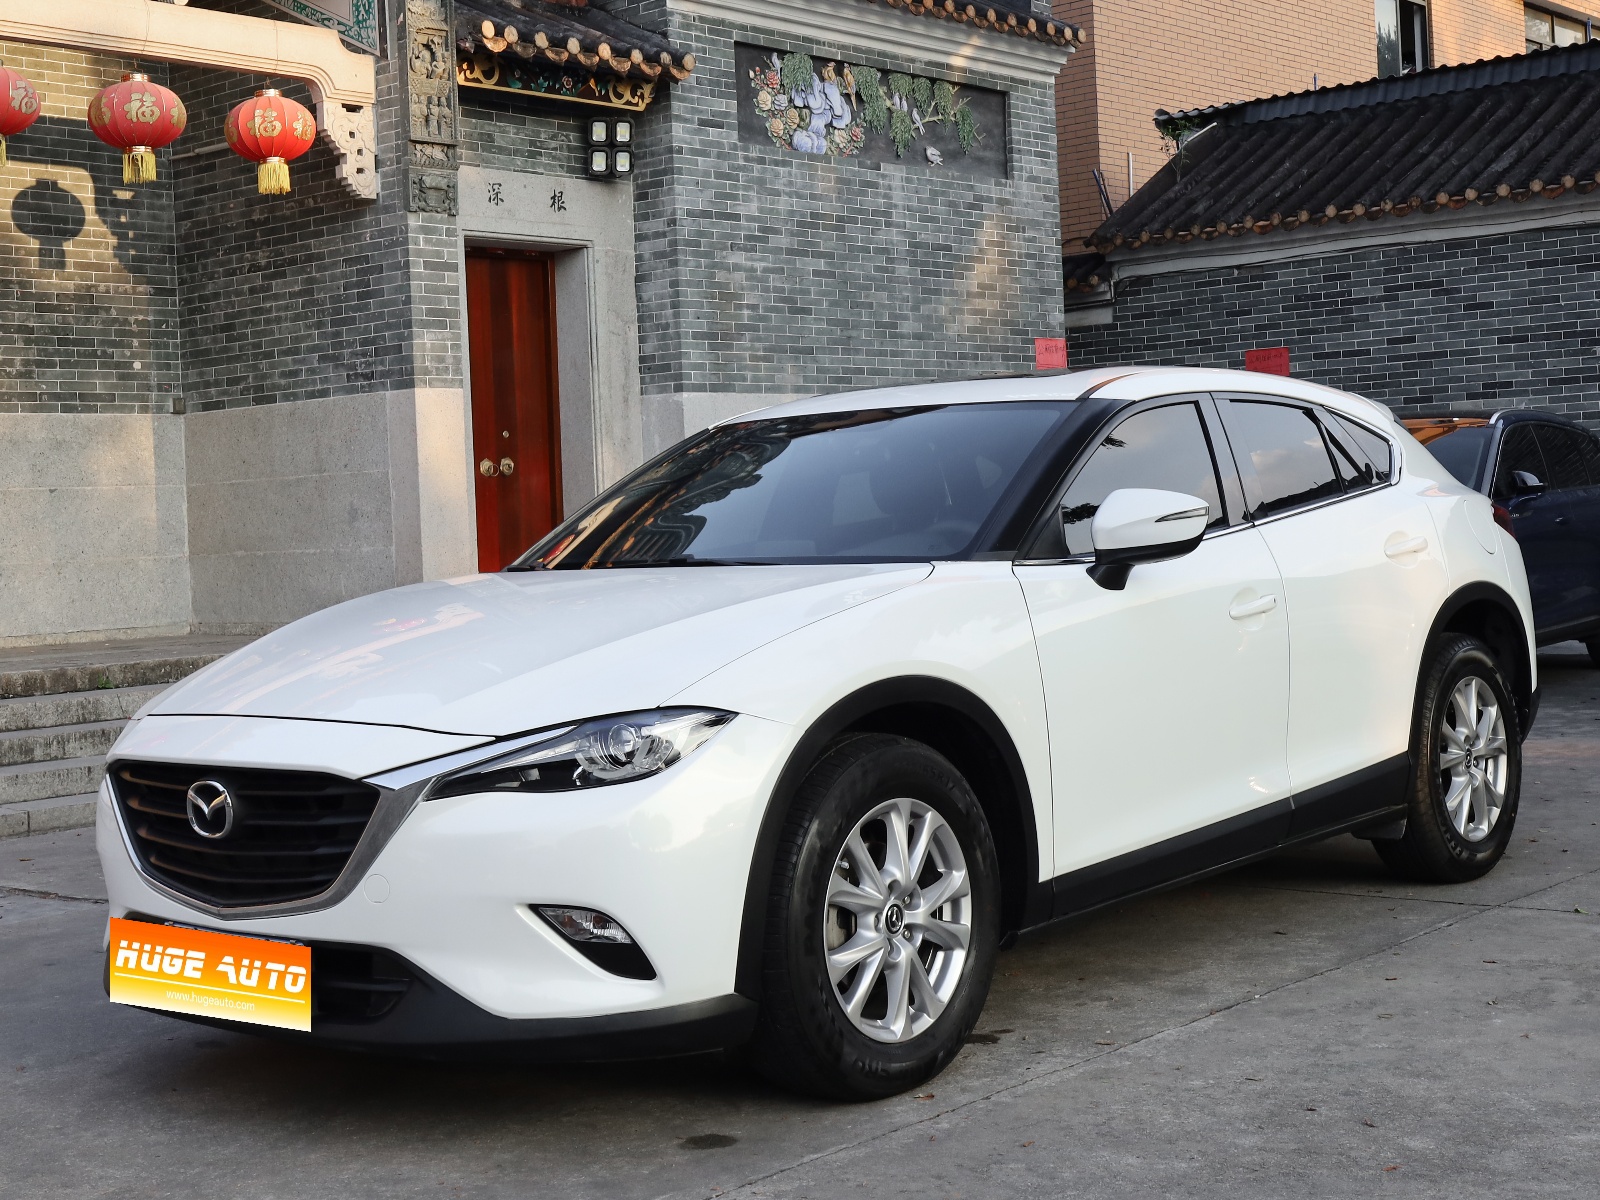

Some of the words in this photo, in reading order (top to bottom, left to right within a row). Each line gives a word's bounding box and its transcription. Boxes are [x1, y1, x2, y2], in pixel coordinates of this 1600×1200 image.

[11, 80, 38, 114] 福
[123, 91, 161, 124] 福
[246, 108, 282, 138] 福
